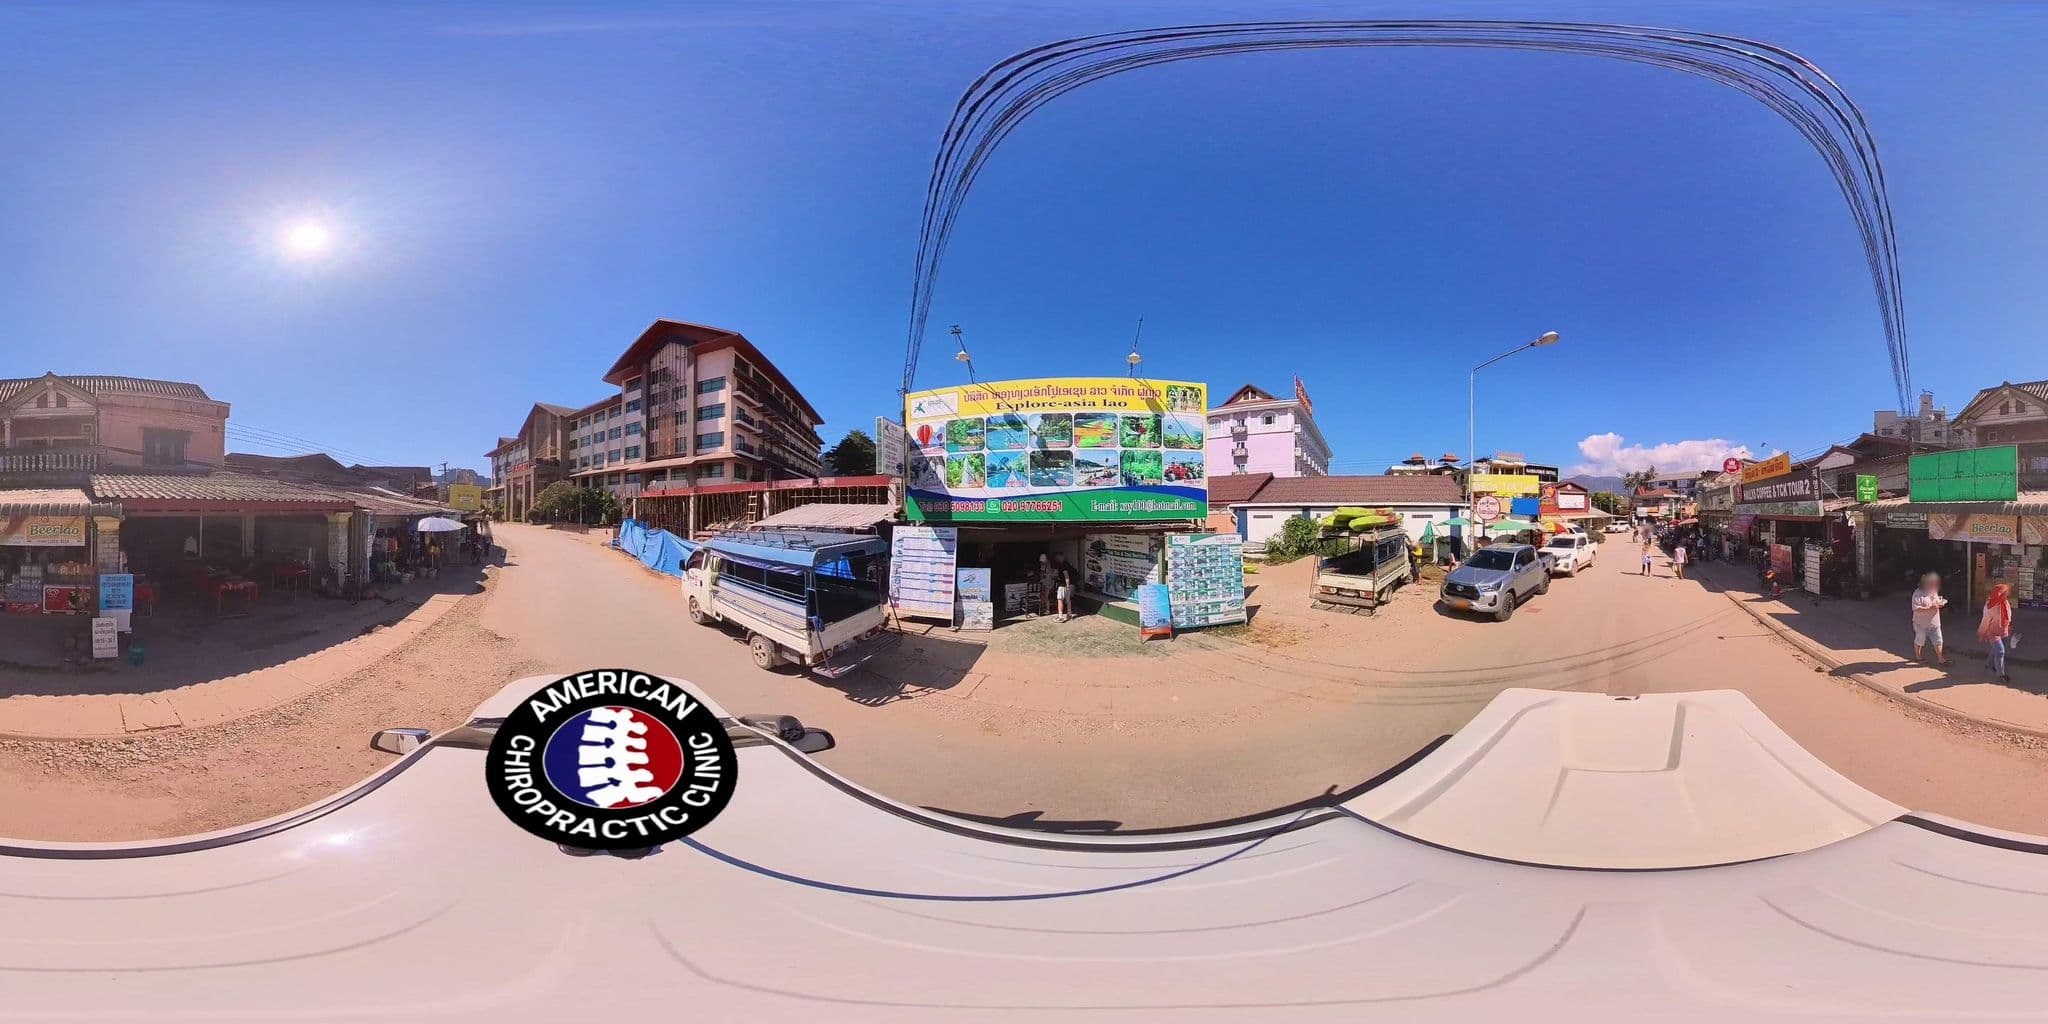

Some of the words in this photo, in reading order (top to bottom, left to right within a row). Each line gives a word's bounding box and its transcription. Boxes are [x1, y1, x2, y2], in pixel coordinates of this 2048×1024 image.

[996, 399, 1096, 411] Explore-asia
[1103, 399, 1128, 408] lao
[1788, 480, 1804, 497] TOUR
[1804, 479, 1810, 495] 2
[1002, 500, 1018, 512] 020
[31, 524, 79, 535] Beerlao
[1972, 523, 2012, 534] Beerlao
